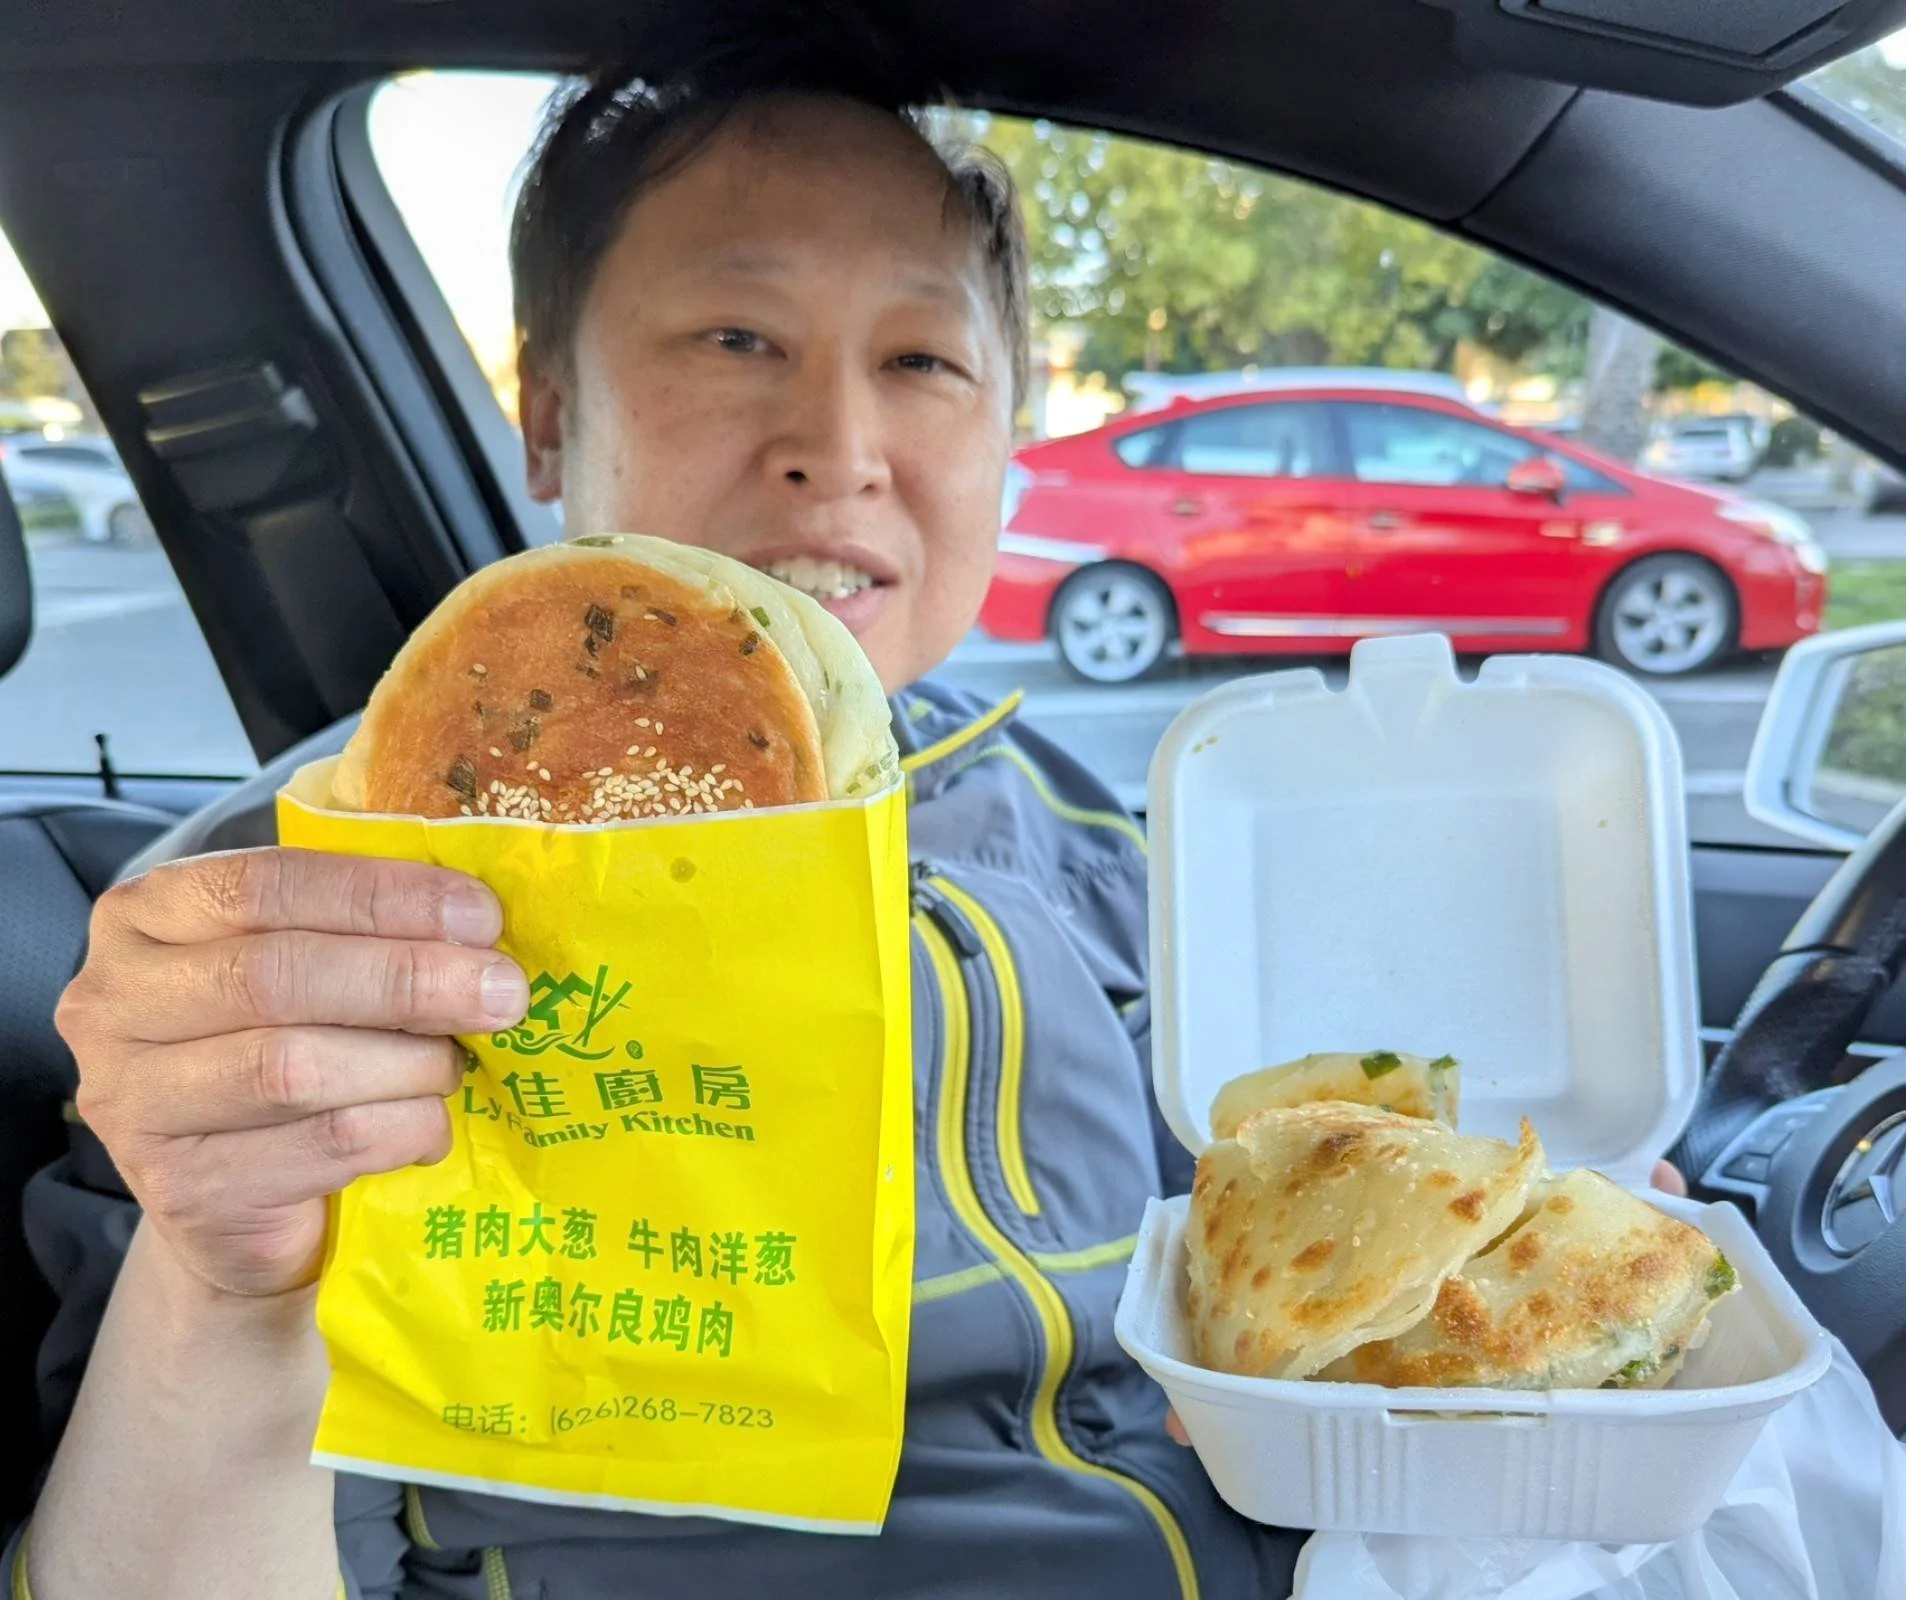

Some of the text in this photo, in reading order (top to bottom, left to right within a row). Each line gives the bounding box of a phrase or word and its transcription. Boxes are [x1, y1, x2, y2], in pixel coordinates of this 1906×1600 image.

[464, 1085, 756, 1148] Ly Family Kitchen
[466, 1054, 751, 1118] 佳廚房
[423, 1202, 797, 1286] 猪肉大葱 牛肉洋葱
[482, 1275, 734, 1358] 新奥尔良鸡肉
[550, 1395, 775, 1436] (626)268-7823
